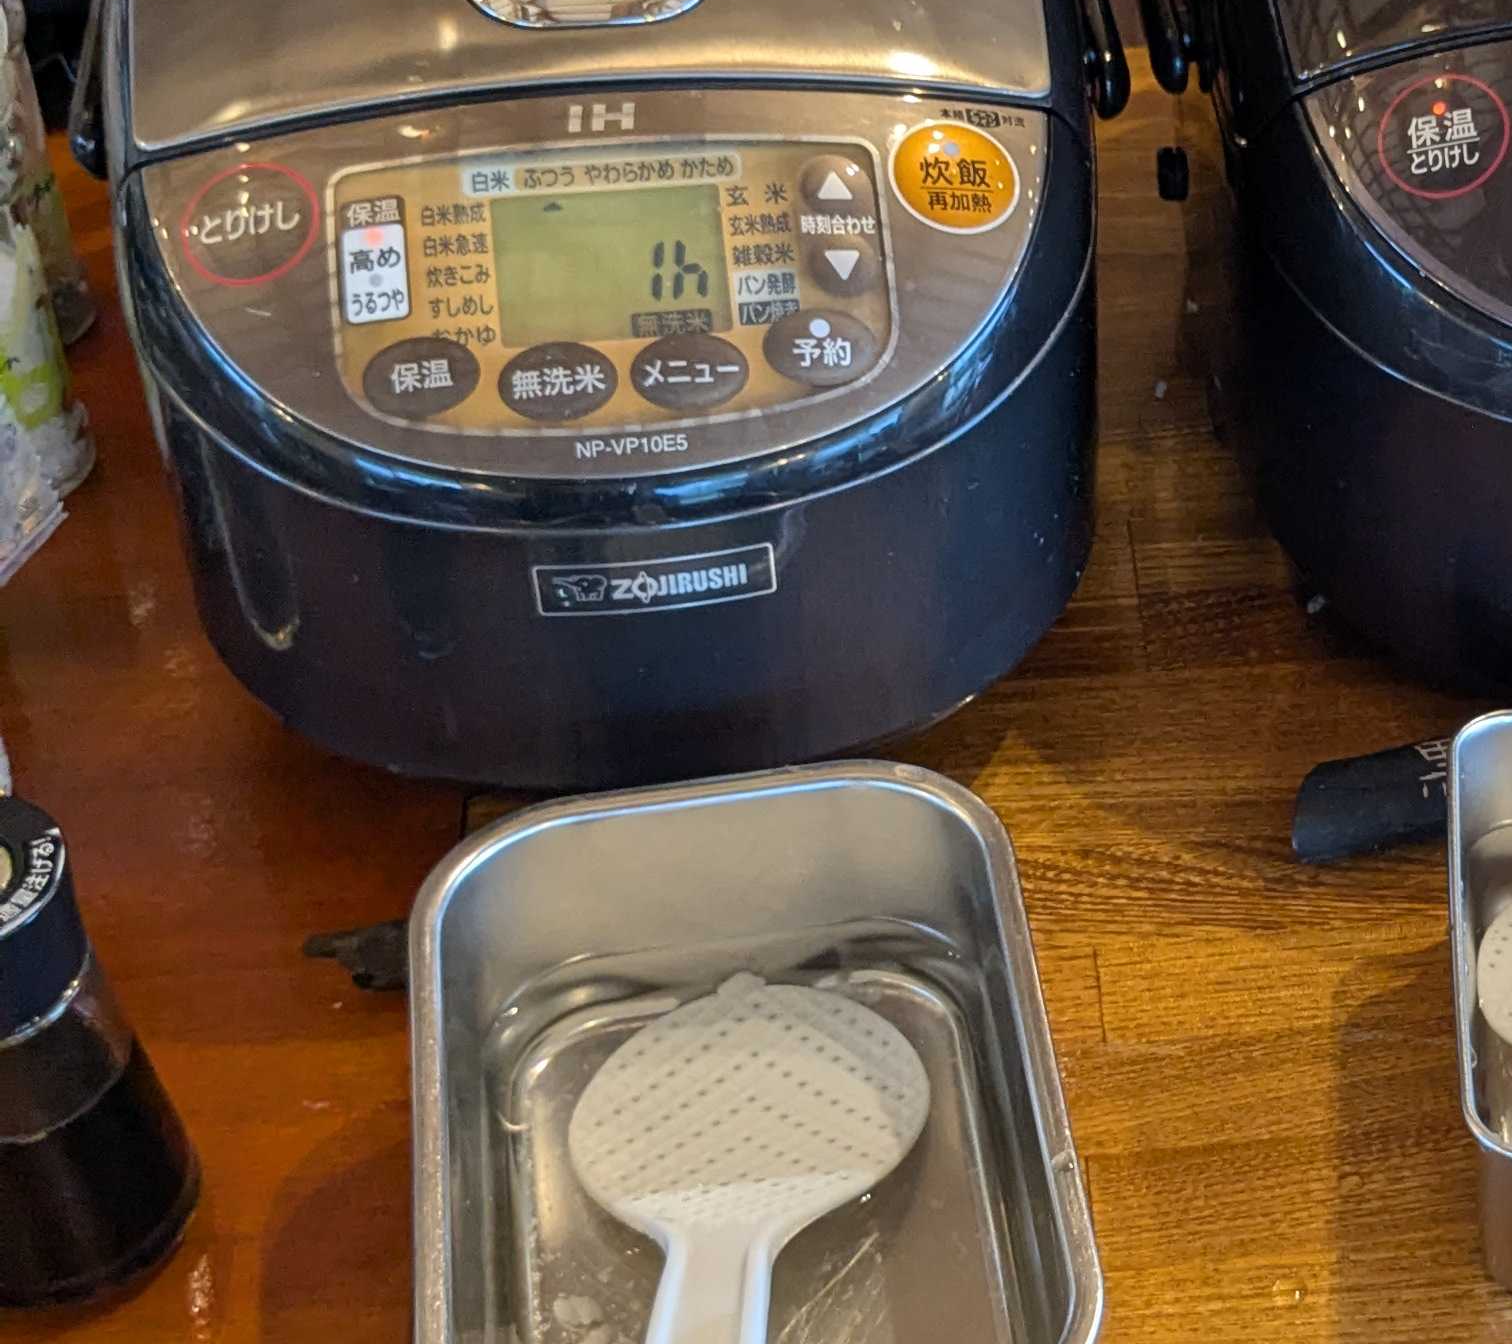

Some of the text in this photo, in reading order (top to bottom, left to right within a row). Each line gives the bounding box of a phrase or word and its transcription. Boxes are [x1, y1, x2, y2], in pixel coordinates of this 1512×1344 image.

[568, 104, 634, 131] IH
[1408, 109, 1479, 146] 保温
[920, 157, 990, 188] 炊飯
[1410, 145, 1480, 174] とりけし
[471, 157, 734, 192] 白米 ふつう やわらかめ かため
[346, 200, 400, 224] 保温
[420, 204, 486, 227] 白米熟成
[928, 190, 992, 214] 再加熱
[199, 203, 300, 243] とりけし
[729, 213, 791, 237] 玄米熟成
[801, 214, 876, 236] 時刻合わせ
[423, 233, 488, 256] 白米急速
[349, 247, 400, 273] 高め
[426, 265, 491, 288] 炊きこみ
[737, 272, 796, 296] パン発酵
[351, 289, 404, 316] うるつや
[429, 295, 493, 318] すしめし
[792, 336, 852, 367] 予約
[390, 358, 454, 393] 保温
[511, 367, 606, 400] 無洗米
[642, 359, 740, 388] メニュー
[575, 434, 689, 459] NP-VP10E5
[612, 564, 748, 603] ZOJIRUSHI
